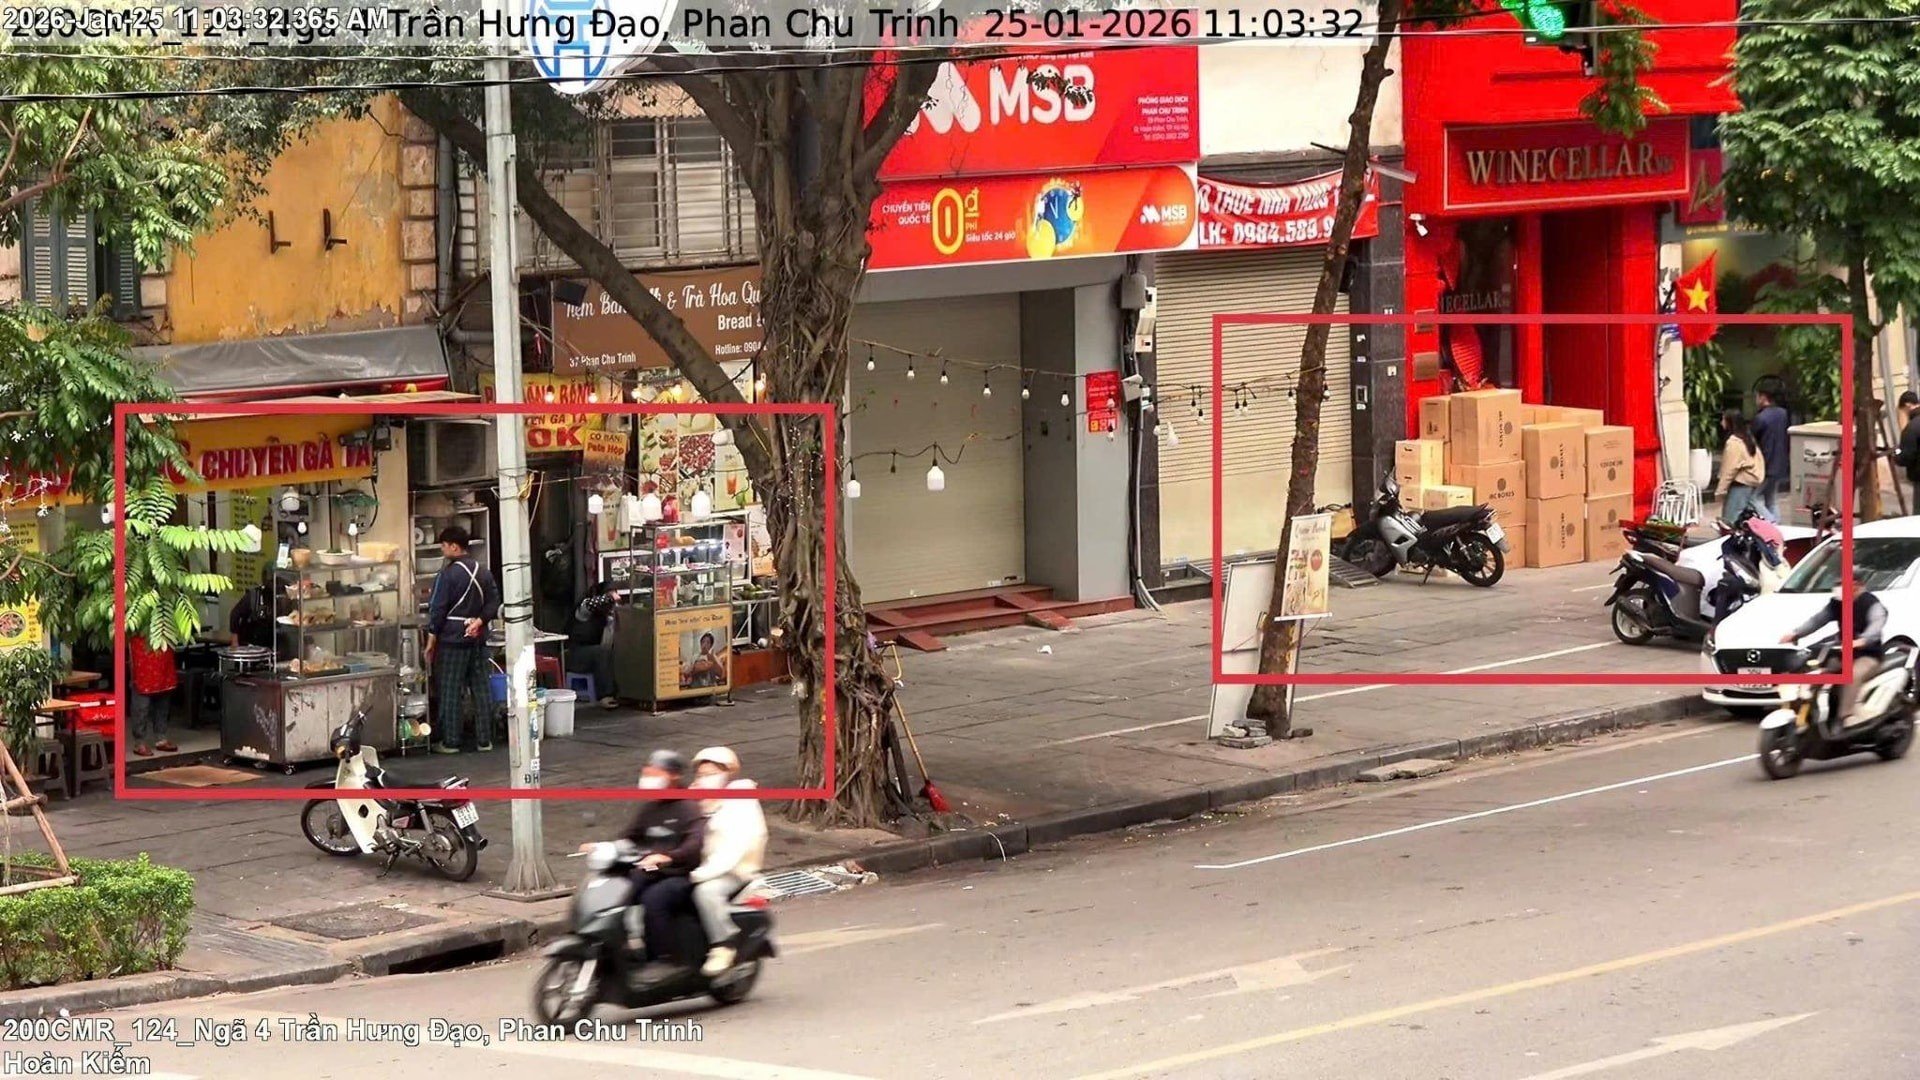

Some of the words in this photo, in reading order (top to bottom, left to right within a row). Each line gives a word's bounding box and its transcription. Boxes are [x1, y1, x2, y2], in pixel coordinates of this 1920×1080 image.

[990, 64, 1096, 125] MSB
[1466, 142, 1654, 186] WINECELLAR
[1161, 204, 1188, 220] MSB
[1199, 221, 1226, 244] LH:
[1233, 215, 1335, 244] 0984.589.9
[666, 291, 677, 310] &
[682, 285, 705, 309] Trà
[709, 283, 739, 307] Hoa
[717, 313, 752, 330] Bread
[601, 353, 616, 365] Chu
[617, 351, 637, 363] Trinh
[715, 344, 742, 355] Hotline:
[527, 426, 583, 448] OK
[302, 432, 333, 471] GÀ
